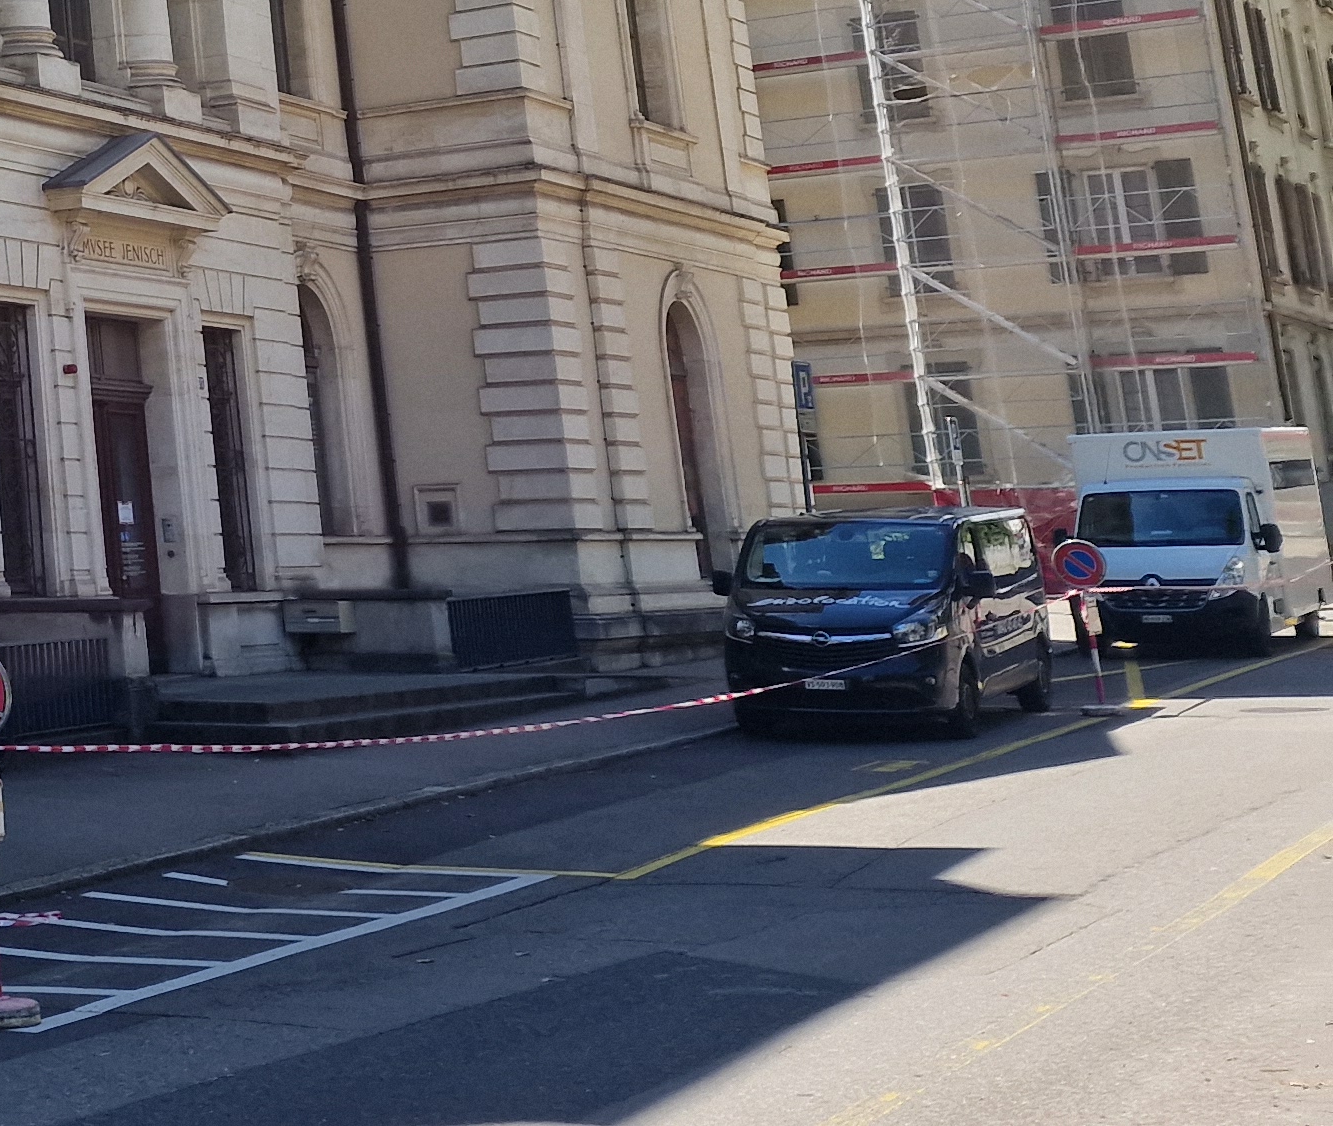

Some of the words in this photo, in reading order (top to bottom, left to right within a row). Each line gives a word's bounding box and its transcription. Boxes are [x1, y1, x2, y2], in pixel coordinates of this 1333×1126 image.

[1102, 15, 1142, 26] RICHARD
[1116, 127, 1156, 137] RICHARD
[1133, 240, 1173, 249] RICHARD
[122, 242, 165, 265] JENISCH
[797, 268, 833, 276] RICHARD
[1123, 438, 1207, 462] ONSET
